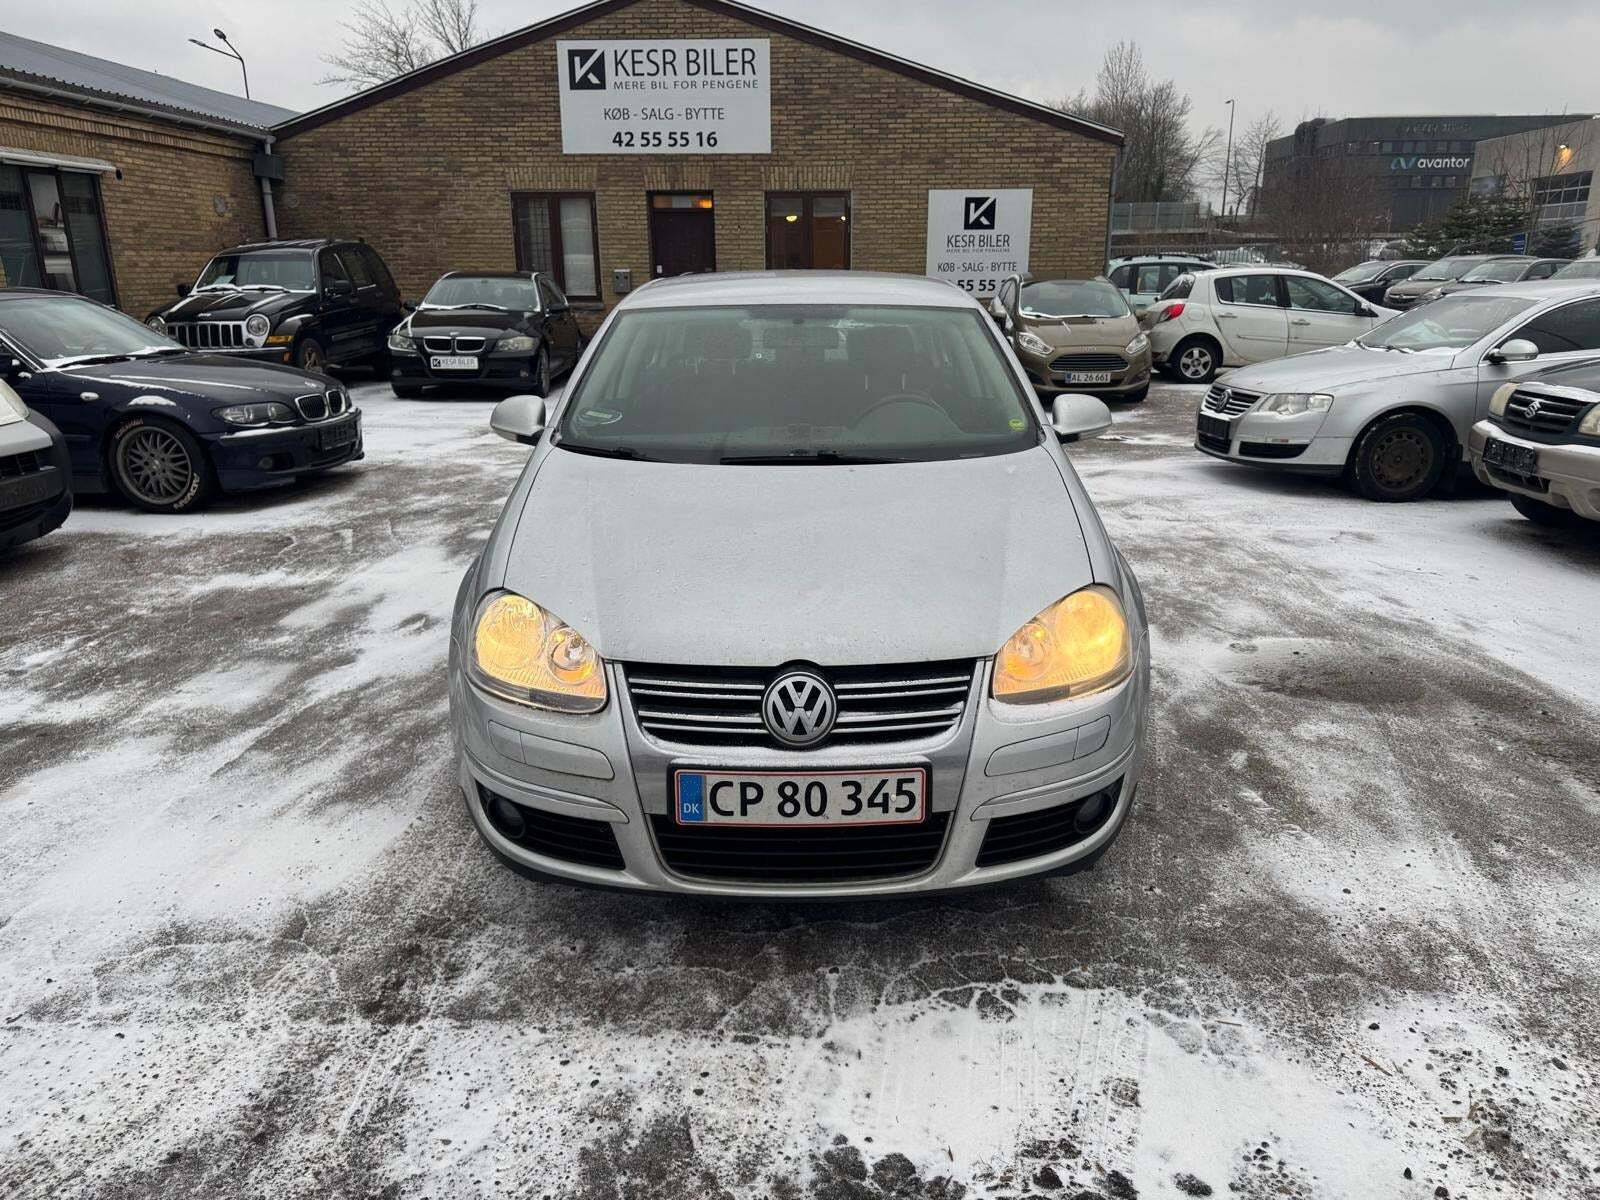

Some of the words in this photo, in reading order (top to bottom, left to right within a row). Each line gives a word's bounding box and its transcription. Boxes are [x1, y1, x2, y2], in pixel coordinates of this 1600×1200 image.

[613, 49, 678, 77] KESR
[686, 48, 756, 76] BILER
[613, 81, 646, 90] MERE
[650, 80, 669, 90] BIL
[673, 80, 698, 89] FOR
[702, 79, 759, 89] PENGENE
[604, 107, 630, 120] KØB
[641, 107, 674, 120] SALG
[685, 107, 725, 120] BYTTE
[612, 131, 635, 147] 42
[640, 131, 662, 147] 55
[667, 131, 690, 147] 55
[696, 131, 718, 147] 16
[1417, 156, 1470, 168] avantor
[946, 235, 976, 248] KESR
[978, 234, 1010, 248] BILER
[937, 262, 955, 272] KØB
[962, 262, 984, 272] SALG
[990, 262, 1017, 272] BYTTE
[978, 279, 996, 291] 55
[709, 780, 764, 817] CP
[777, 780, 828, 818] 80
[841, 777, 916, 816] 345
[683, 802, 700, 814] DK
